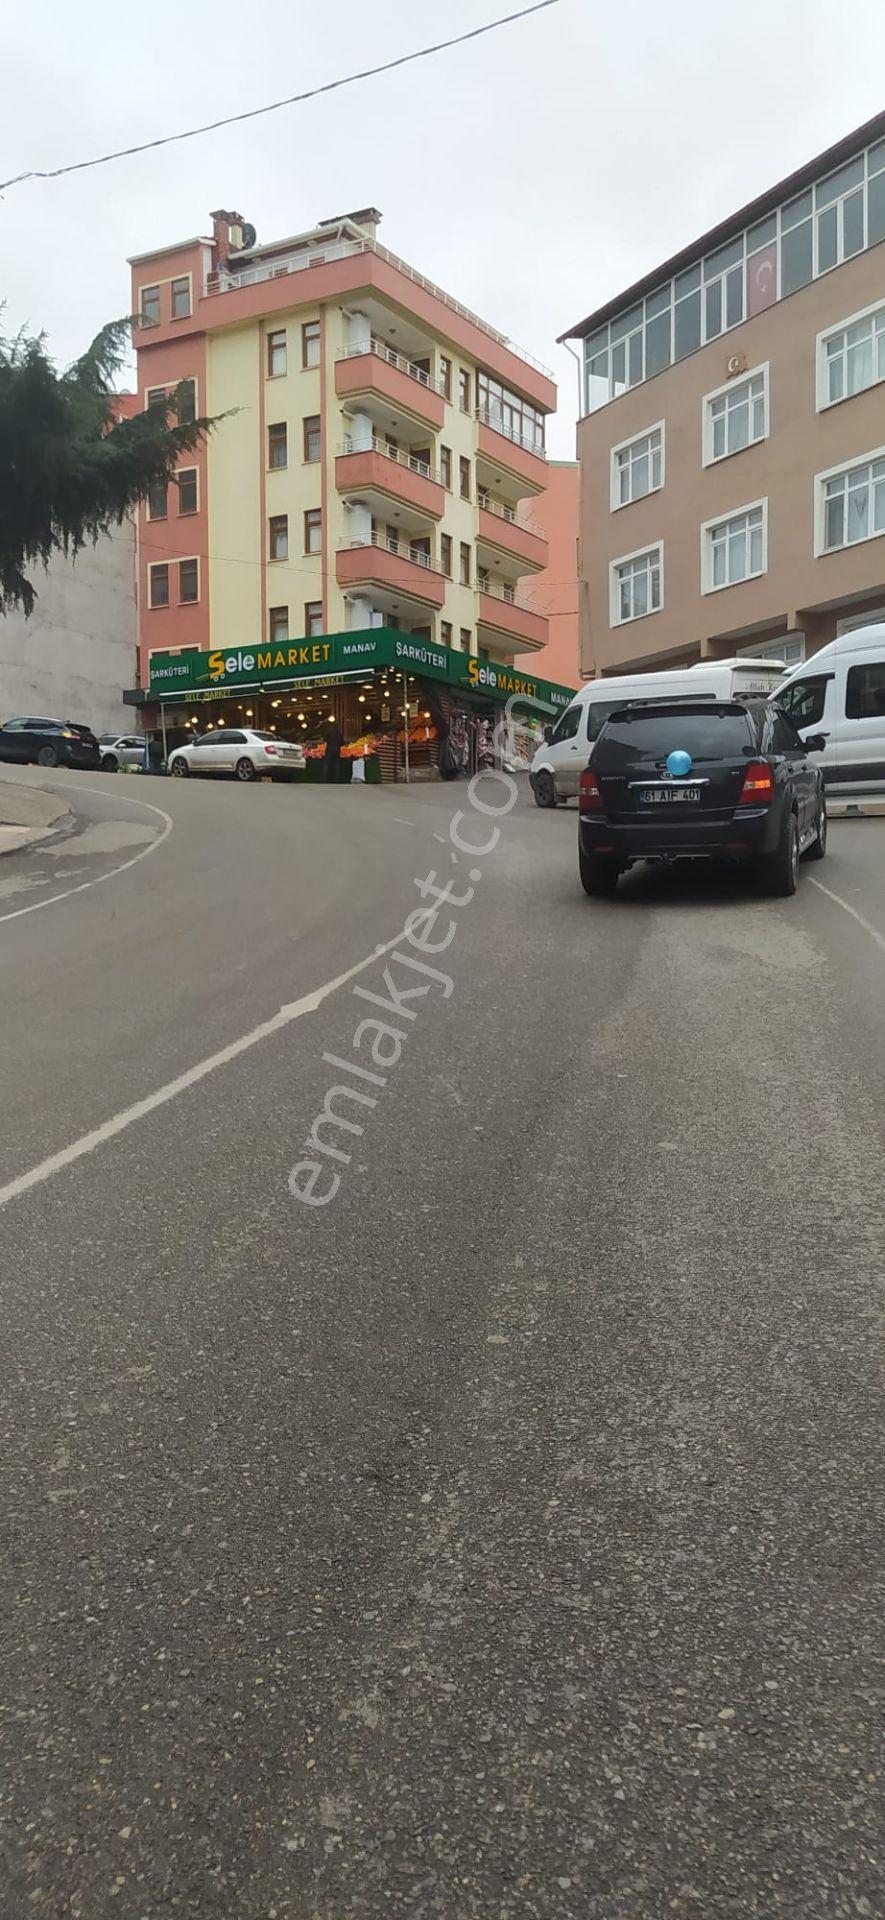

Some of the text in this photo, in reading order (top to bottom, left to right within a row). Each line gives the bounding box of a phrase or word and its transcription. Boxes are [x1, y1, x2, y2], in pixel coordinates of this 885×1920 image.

[343, 641, 377, 655] MANAV
[396, 641, 447, 669] ŞARKÜTERİ
[257, 643, 330, 669] MARKET
[314, 675, 345, 687] MARKET
[498, 674, 537, 698] MARKET
[204, 689, 232, 699] MARKET
[644, 790, 656, 801] 61
[682, 788, 699, 800] 401
